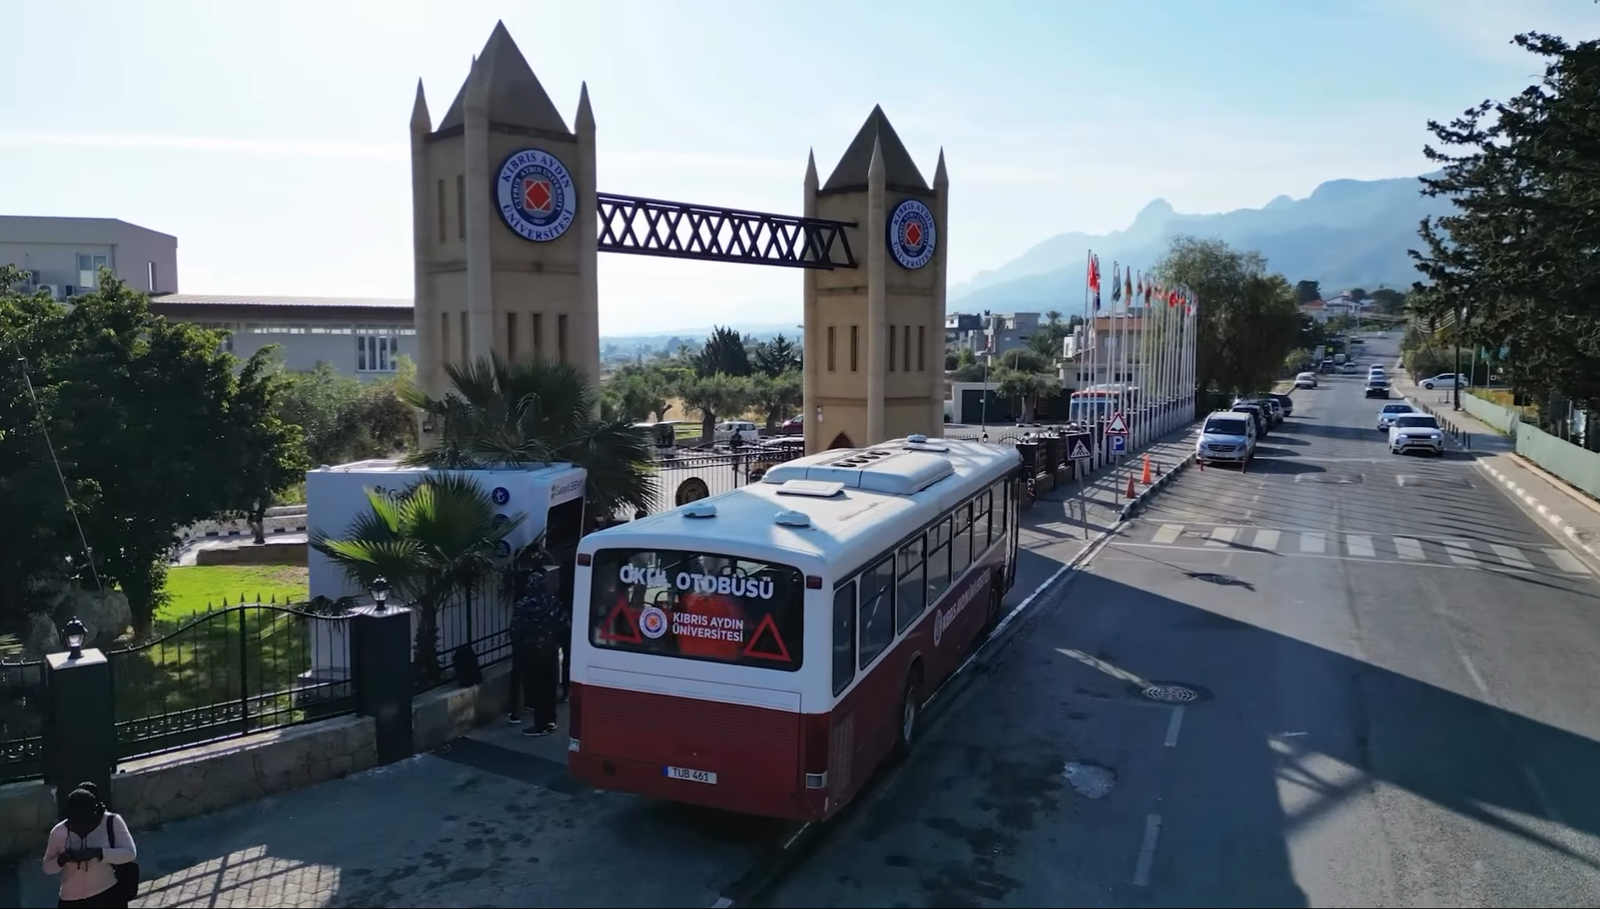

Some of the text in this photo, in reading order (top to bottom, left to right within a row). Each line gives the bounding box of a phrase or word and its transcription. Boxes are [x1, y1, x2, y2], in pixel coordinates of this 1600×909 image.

[502, 152, 571, 189] KIBRIS AYDIN
[503, 204, 573, 240] ÜNİVERSİTESİ
[1113, 435, 1124, 450] P
[675, 571, 774, 600] OTOBÜSÜ
[673, 612, 708, 625] KIBRIS
[709, 616, 744, 629] AYDIN
[672, 624, 744, 643] ÜNİVERSİTESİ
[673, 768, 709, 781] TUB 461
